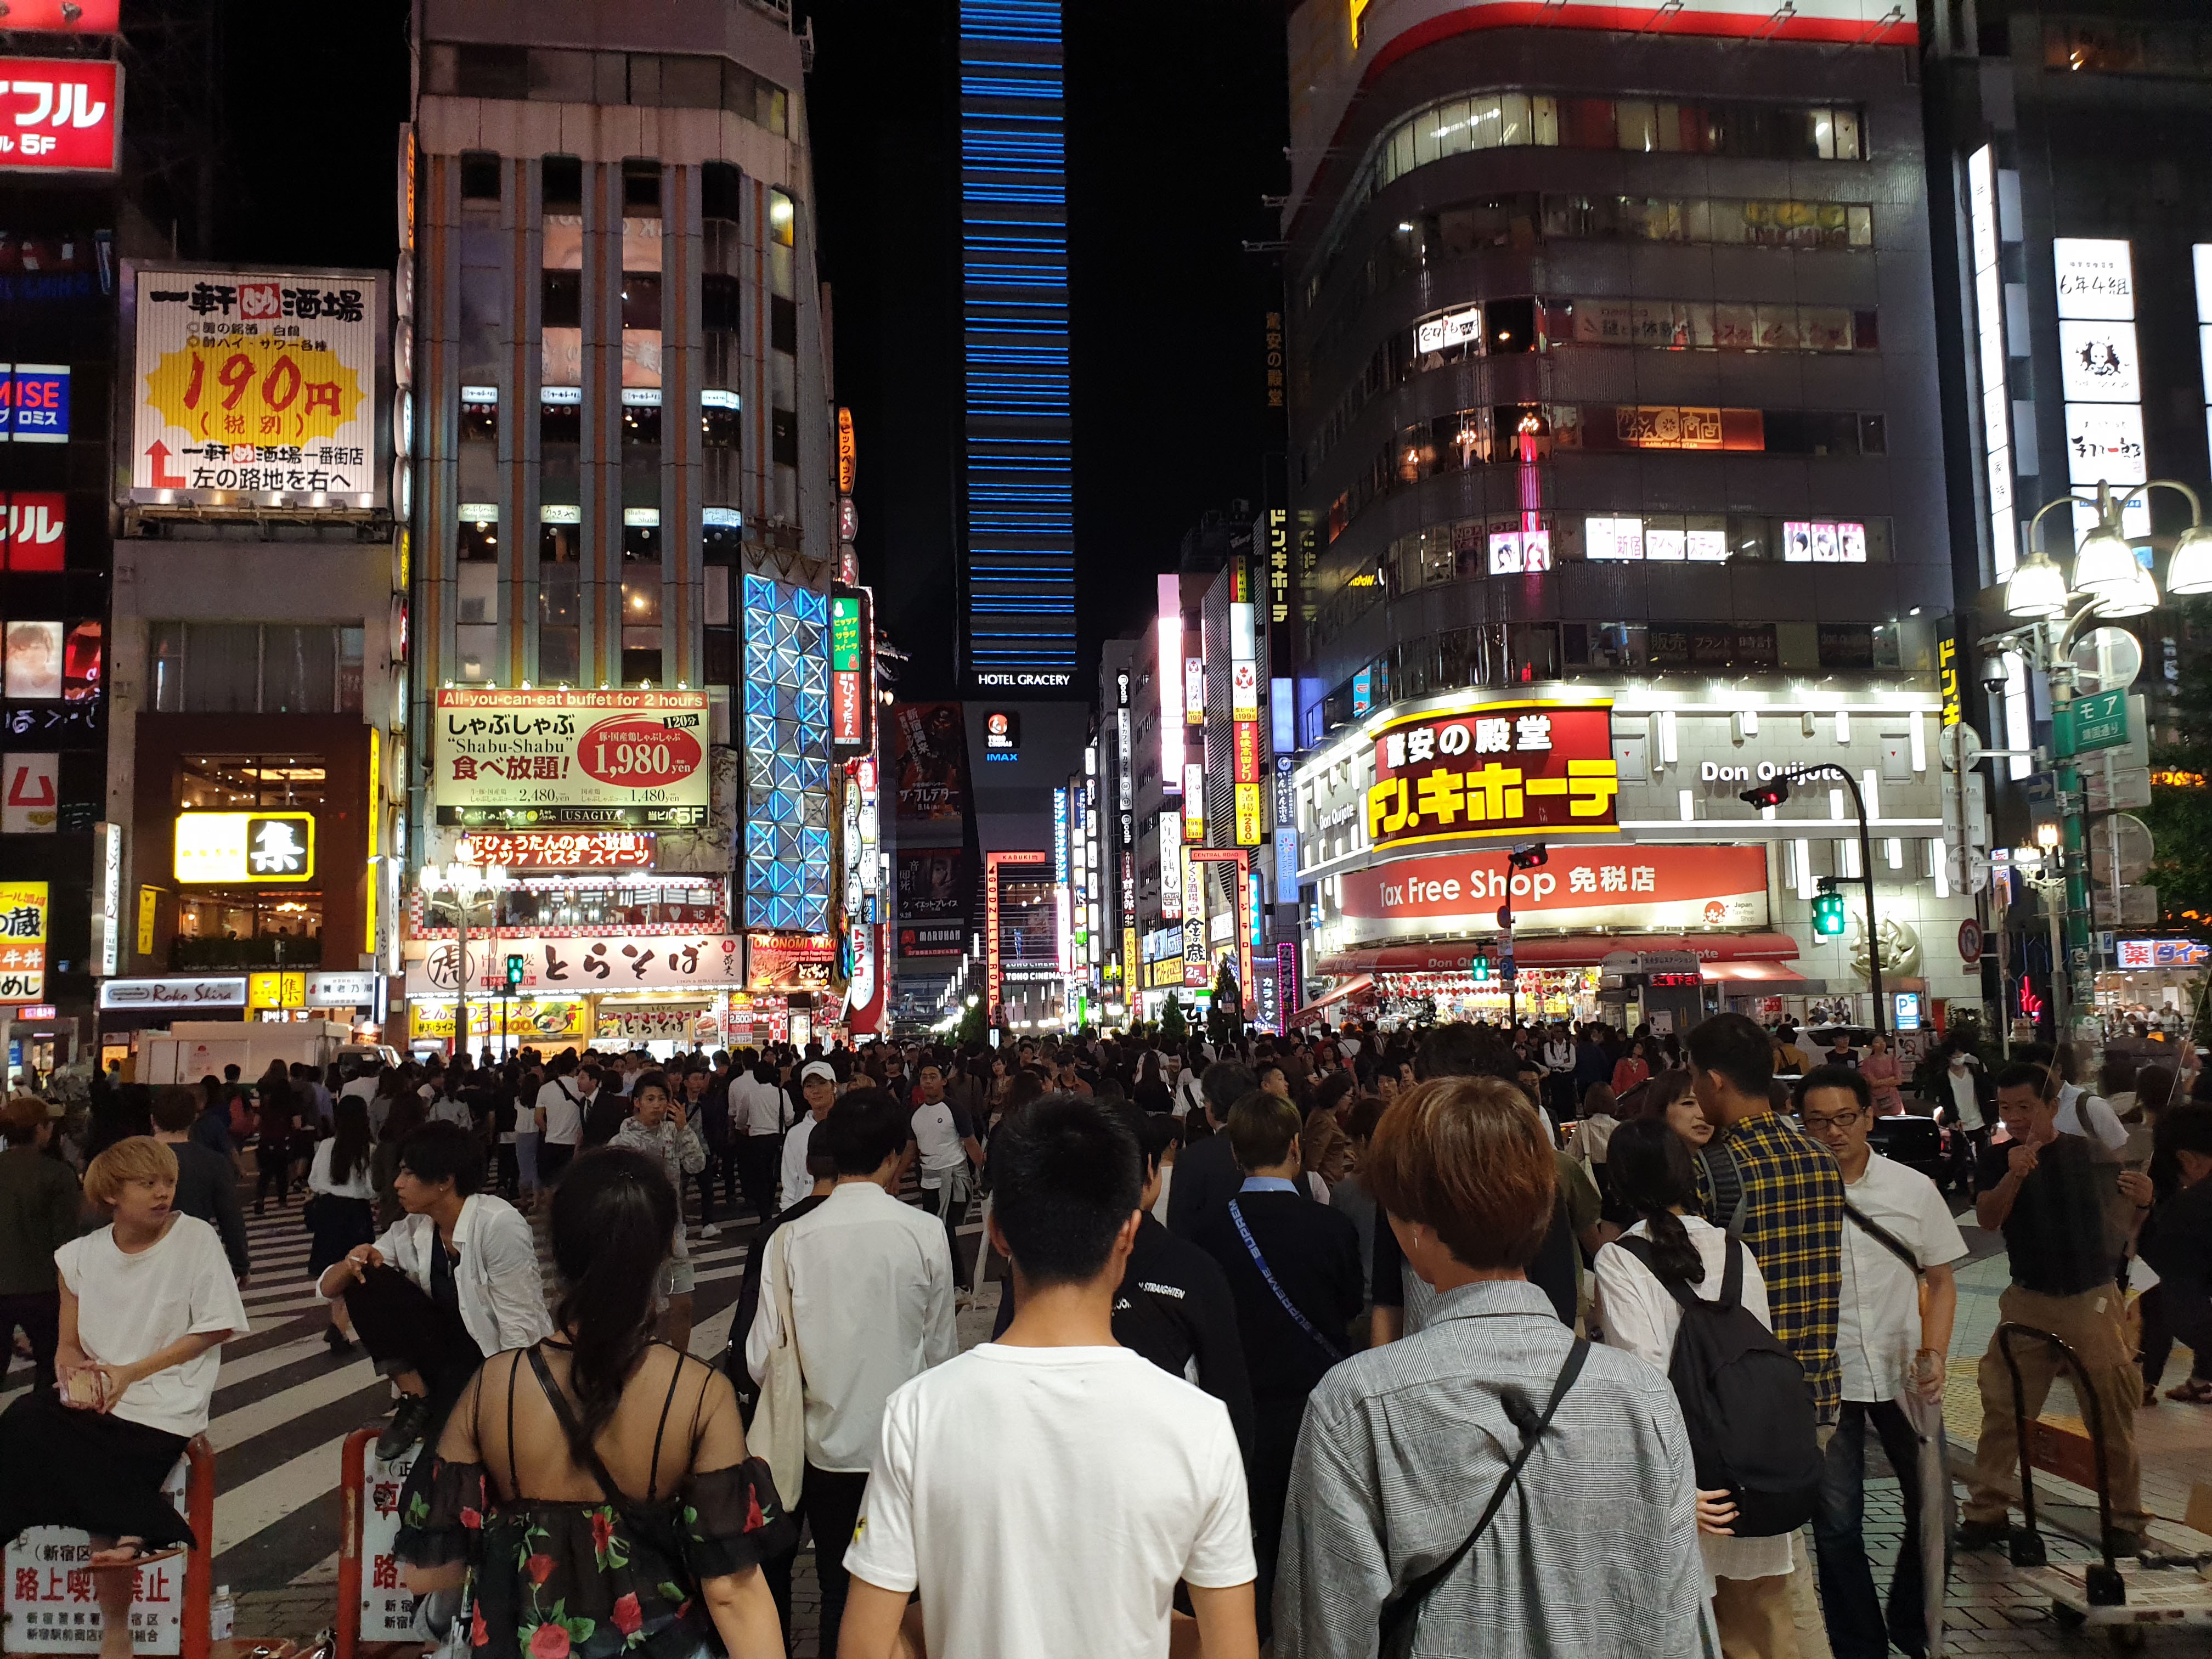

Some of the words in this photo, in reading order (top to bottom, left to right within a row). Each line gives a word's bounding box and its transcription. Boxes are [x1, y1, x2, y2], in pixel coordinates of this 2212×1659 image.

[0, 81, 106, 128] フル
[20, 133, 57, 155] 5F
[183, 351, 342, 417] 190円
[192, 466, 351, 492] 左の路地を右へ
[834, 642, 859, 651] スイーツ
[1650, 633, 1688, 652] 販売
[978, 674, 1015, 685] HOTEL
[1018, 674, 1070, 685] GRACERY
[443, 692, 562, 707] All-you-can-eat
[567, 693, 612, 706] buffet
[617, 694, 639, 706] for
[644, 695, 654, 707] 2
[659, 694, 703, 707] hours
[838, 681, 856, 737] ひょうたん
[448, 714, 575, 736] しゃぶしゃぶ
[665, 715, 697, 729] 120分
[1386, 715, 1553, 769] 驚安の殿堂
[452, 755, 571, 781] 食べ放題!
[594, 744, 670, 779] 1,980
[671, 763, 691, 775] yen
[1701, 761, 1748, 781] Don
[519, 789, 555, 803] 2,480
[555, 794, 570, 804] yen
[630, 788, 665, 803] 1,480
[665, 794, 680, 804] yen
[1242, 793, 1254, 812] 酒場
[566, 810, 622, 821] USAGIYA
[677, 807, 704, 823] 5F
[1320, 815, 1331, 831] Don
[1331, 803, 1353, 825] Quijote
[250, 821, 306, 872] 集
[537, 850, 581, 865] パスタ
[589, 850, 649, 865] スイーツ
[1122, 878, 1134, 911] 甘太郎
[1380, 882, 1404, 908] Tax
[1408, 876, 1461, 904] Free
[1470, 868, 1557, 903] Shop
[1568, 865, 1656, 894] 免税店
[0, 891, 46, 907] ール酒場
[988, 877, 997, 955] GODZILLA
[1165, 910, 1179, 919] B1
[754, 938, 808, 949] OKONOMI
[811, 938, 837, 949] YAKI
[919, 930, 960, 942] MARUHAN
[1185, 917, 1206, 962] 金の蔵
[545, 940, 708, 980] とらそば
[854, 929, 865, 977] トラノコ
[1428, 958, 1453, 968] Don
[2124, 943, 2150, 966] 薬
[989, 963, 998, 1001] ROAD
[1006, 973, 1029, 981] TOHO
[1186, 966, 1200, 979] 2F
[1282, 946, 1291, 998] カラオケ
[281, 978, 301, 1002] 集
[1263, 977, 1275, 1020] カラオケ
[1143, 1282, 1185, 1299] STRAIGHTEN
